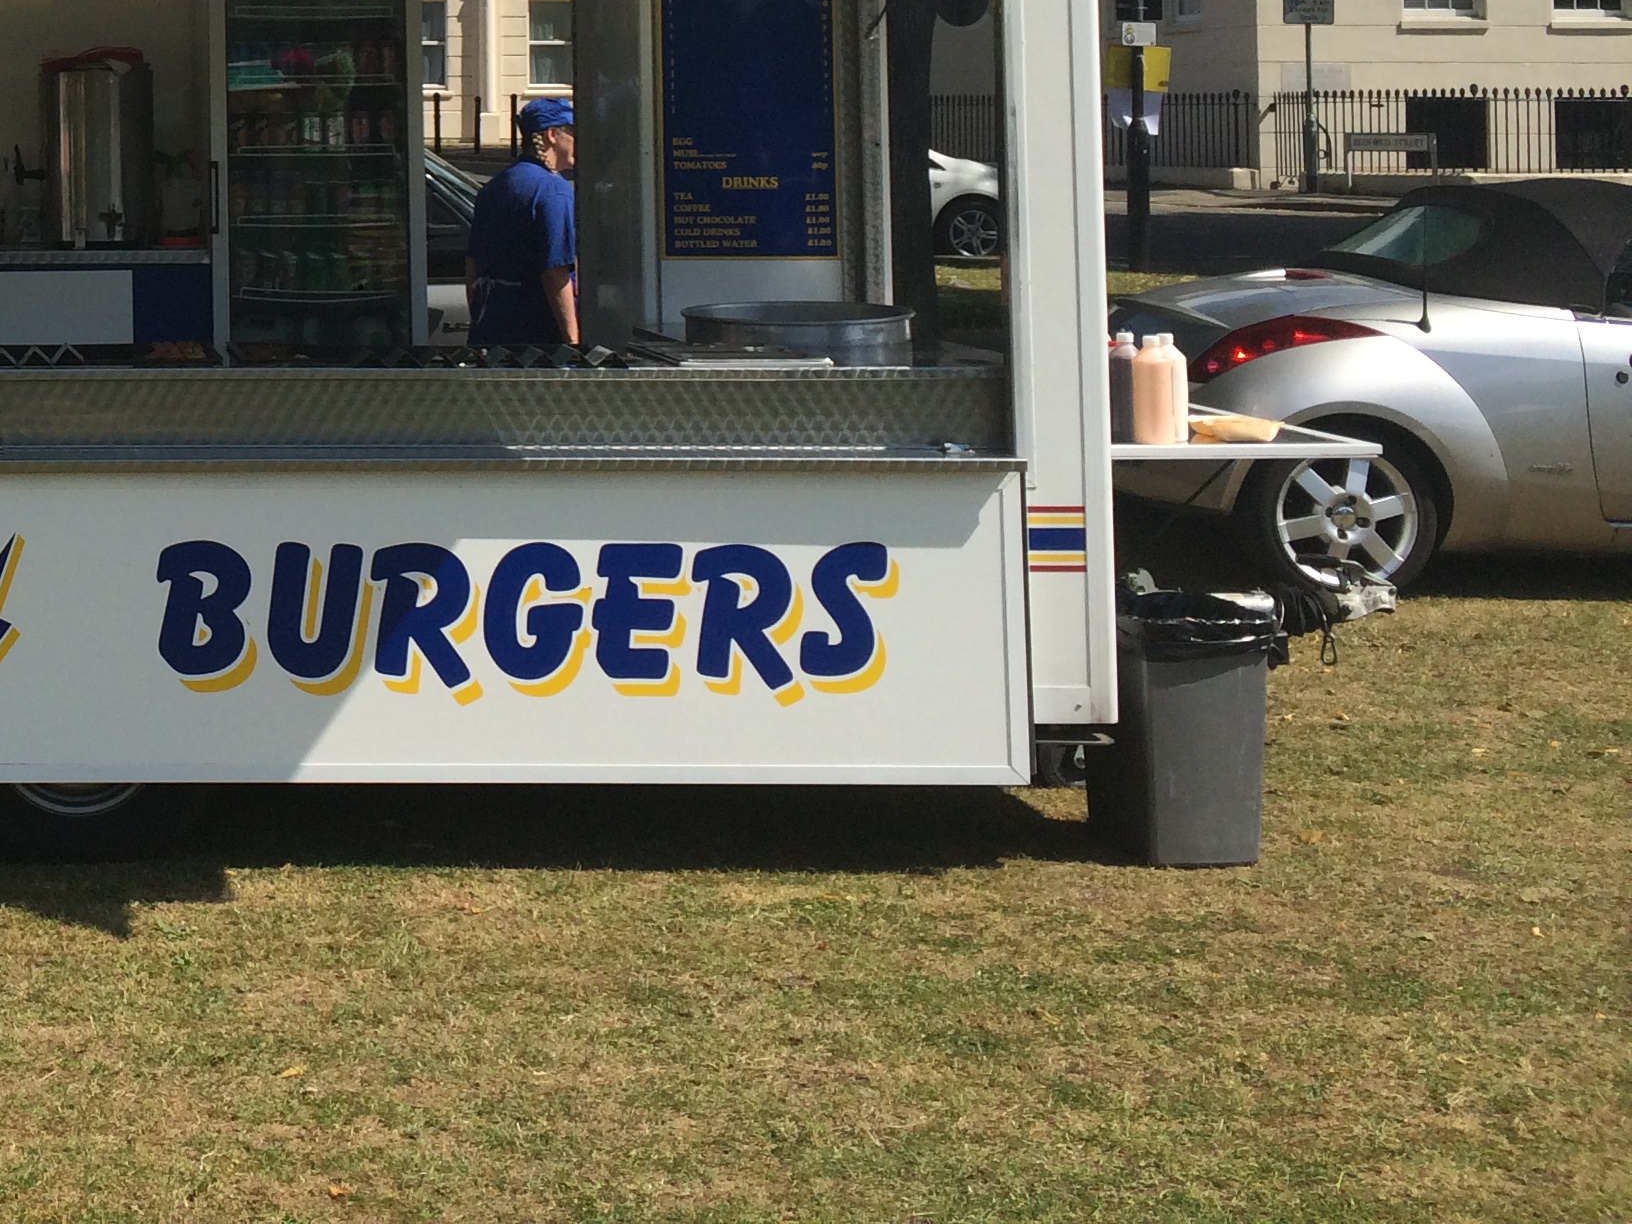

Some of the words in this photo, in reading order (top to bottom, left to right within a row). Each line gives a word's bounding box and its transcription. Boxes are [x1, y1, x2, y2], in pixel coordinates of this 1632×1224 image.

[672, 137, 693, 146] EGG
[673, 161, 728, 170] TOMATOES
[721, 176, 779, 189] DRINKS
[674, 192, 693, 201] TEA
[674, 204, 711, 212] COFFEE
[674, 216, 695, 224] HOT
[696, 216, 756, 224] CHOCOLATE
[675, 228, 701, 236] COLD
[703, 228, 741, 236] DRINKS
[675, 240, 719, 249] BOTTLED
[722, 239, 758, 248] WATER
[156, 538, 901, 709] BURGERS
